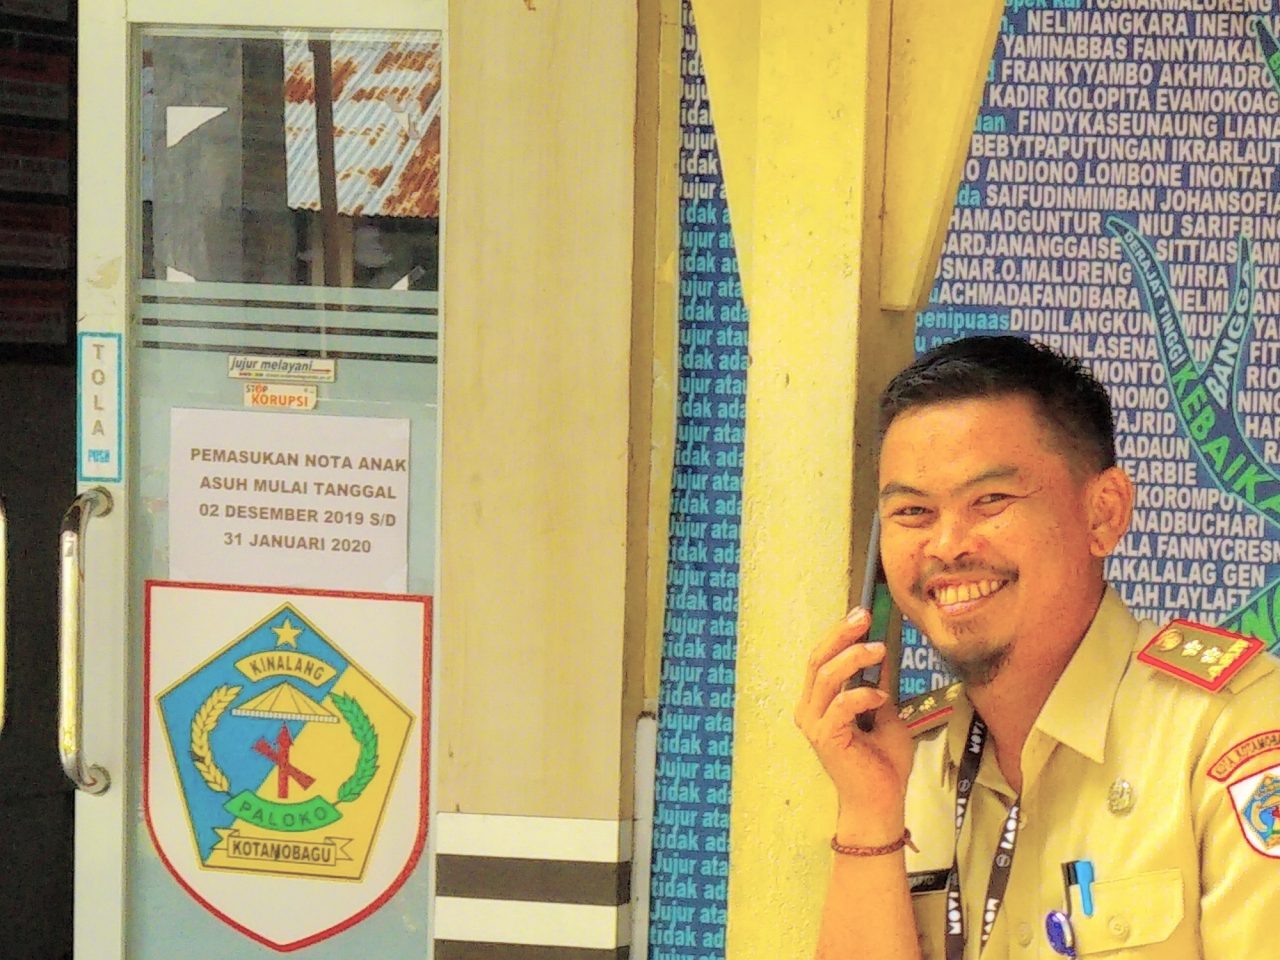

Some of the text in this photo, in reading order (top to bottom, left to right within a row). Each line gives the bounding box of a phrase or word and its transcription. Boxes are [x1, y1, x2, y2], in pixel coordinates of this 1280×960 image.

[1028, 11, 1188, 35] NELMIANGKARA
[1003, 35, 1127, 60] YAMINABBAS
[989, 86, 1149, 111] KADIR KOLOPITA
[986, 161, 1182, 187] ANDIONO LOMBONE
[1138, 214, 1174, 236] NIU
[1123, 231, 1187, 368] DERAJAT TINGGI
[230, 356, 314, 373] jujur melayani
[251, 393, 309, 407] KORUPSI
[190, 447, 407, 472] PEMASUKAN NOTA ANAK
[200, 476, 397, 499] ASUH MULAI TANGGAL
[199, 503, 396, 528] 02 DESEMBER 2019 S/D
[223, 532, 371, 554] 31 JANUARI 2020
[250, 655, 325, 681] KINALANG
[239, 802, 328, 828] PALOKO
[232, 842, 331, 864] KOTAMOBAGU
